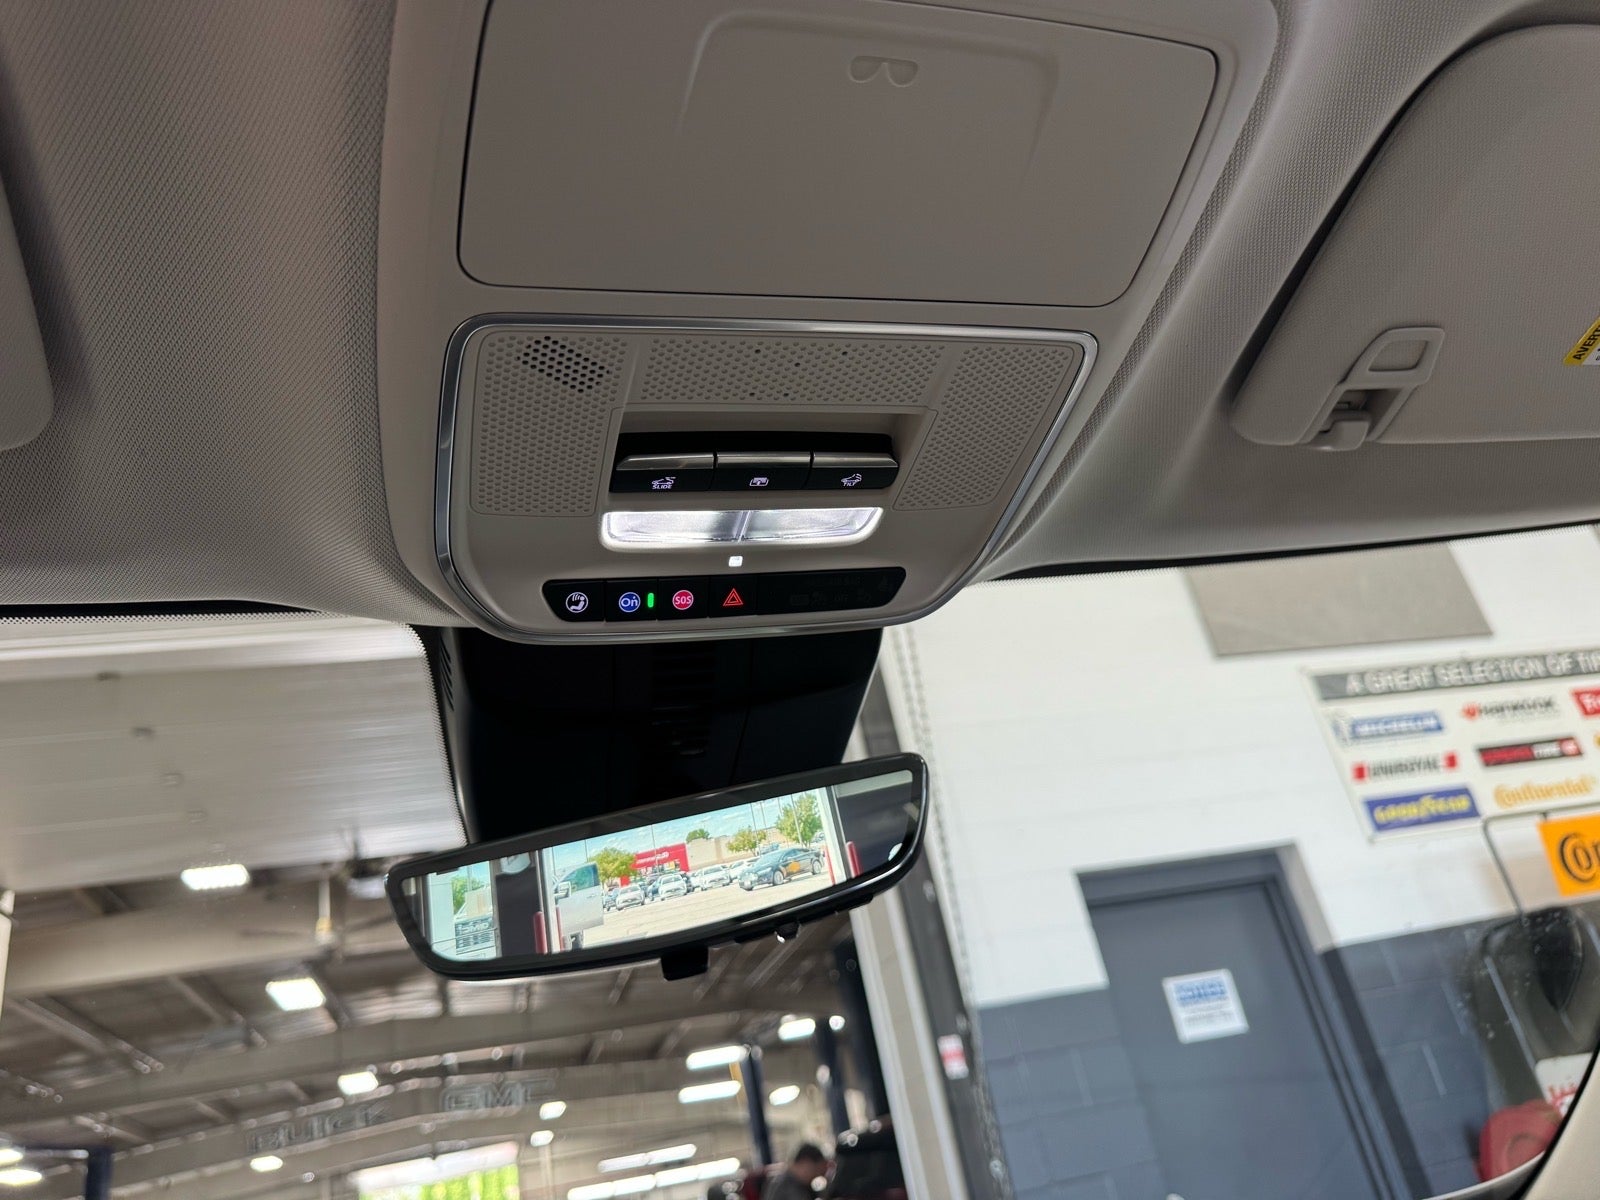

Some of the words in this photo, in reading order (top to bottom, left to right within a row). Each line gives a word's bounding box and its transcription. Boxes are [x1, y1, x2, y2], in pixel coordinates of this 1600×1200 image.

[1572, 324, 1600, 360] AVERT
[674, 596, 692, 605] SOS
[1363, 664, 1432, 694] GREAT
[1434, 655, 1546, 687] SELECTION
[1546, 652, 1575, 676] OF
